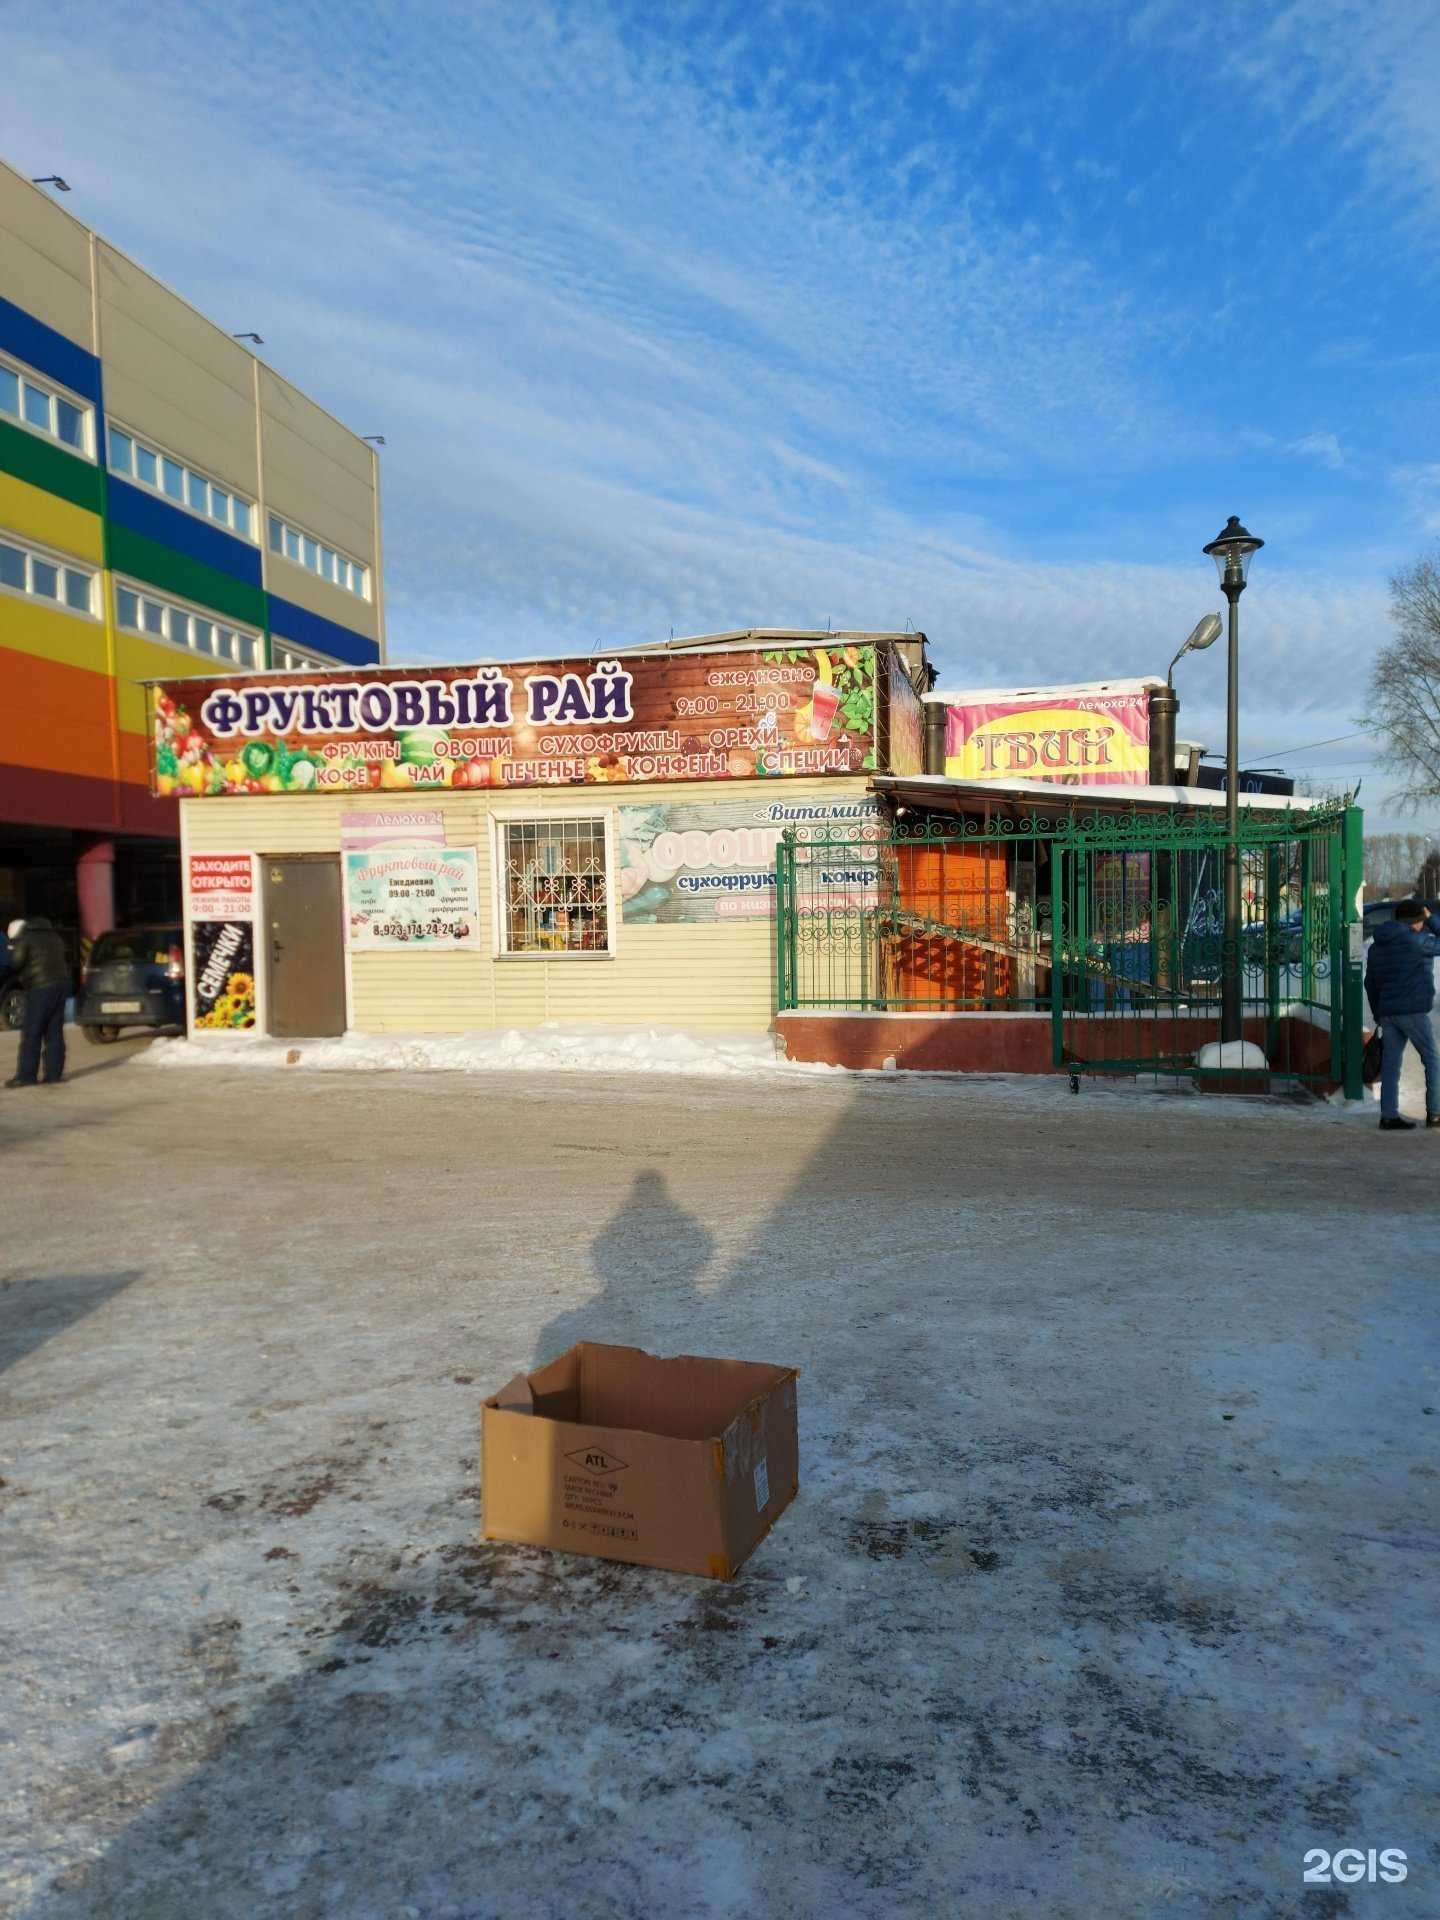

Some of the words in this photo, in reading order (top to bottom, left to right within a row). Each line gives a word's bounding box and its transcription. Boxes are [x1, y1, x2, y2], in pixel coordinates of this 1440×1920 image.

[708, 666, 816, 687] ежедневно
[205, 670, 511, 733] ФРУКТОВЫЙ
[529, 664, 632, 723] РАЙ
[676, 696, 719, 715] 9:00
[736, 692, 790, 711] 21:00
[323, 740, 400, 761] ФРУКТЫ
[433, 737, 513, 759] ОВОЩИ
[539, 730, 682, 755] СУХОФРУКТЫ
[708, 726, 778, 749] ОРЕХИ
[972, 727, 1115, 771] ТВИН
[316, 767, 367, 784] КОФЕ
[407, 763, 446, 782] ЧАЙ
[501, 759, 585, 780] ПЕЧЕНЬЕ
[626, 754, 727, 775] КОНФЕТЫ
[762, 748, 850, 770] СПЕЦИИ
[652, 827, 812, 868] ОВОЩ
[191, 876, 251, 889] ОТКРЫТО
[415, 887, 435, 898] 21:00
[677, 867, 797, 891] сухофрук
[197, 923, 244, 998] СЕМЕЧКИ
[585, 1454, 608, 1468] ATL
